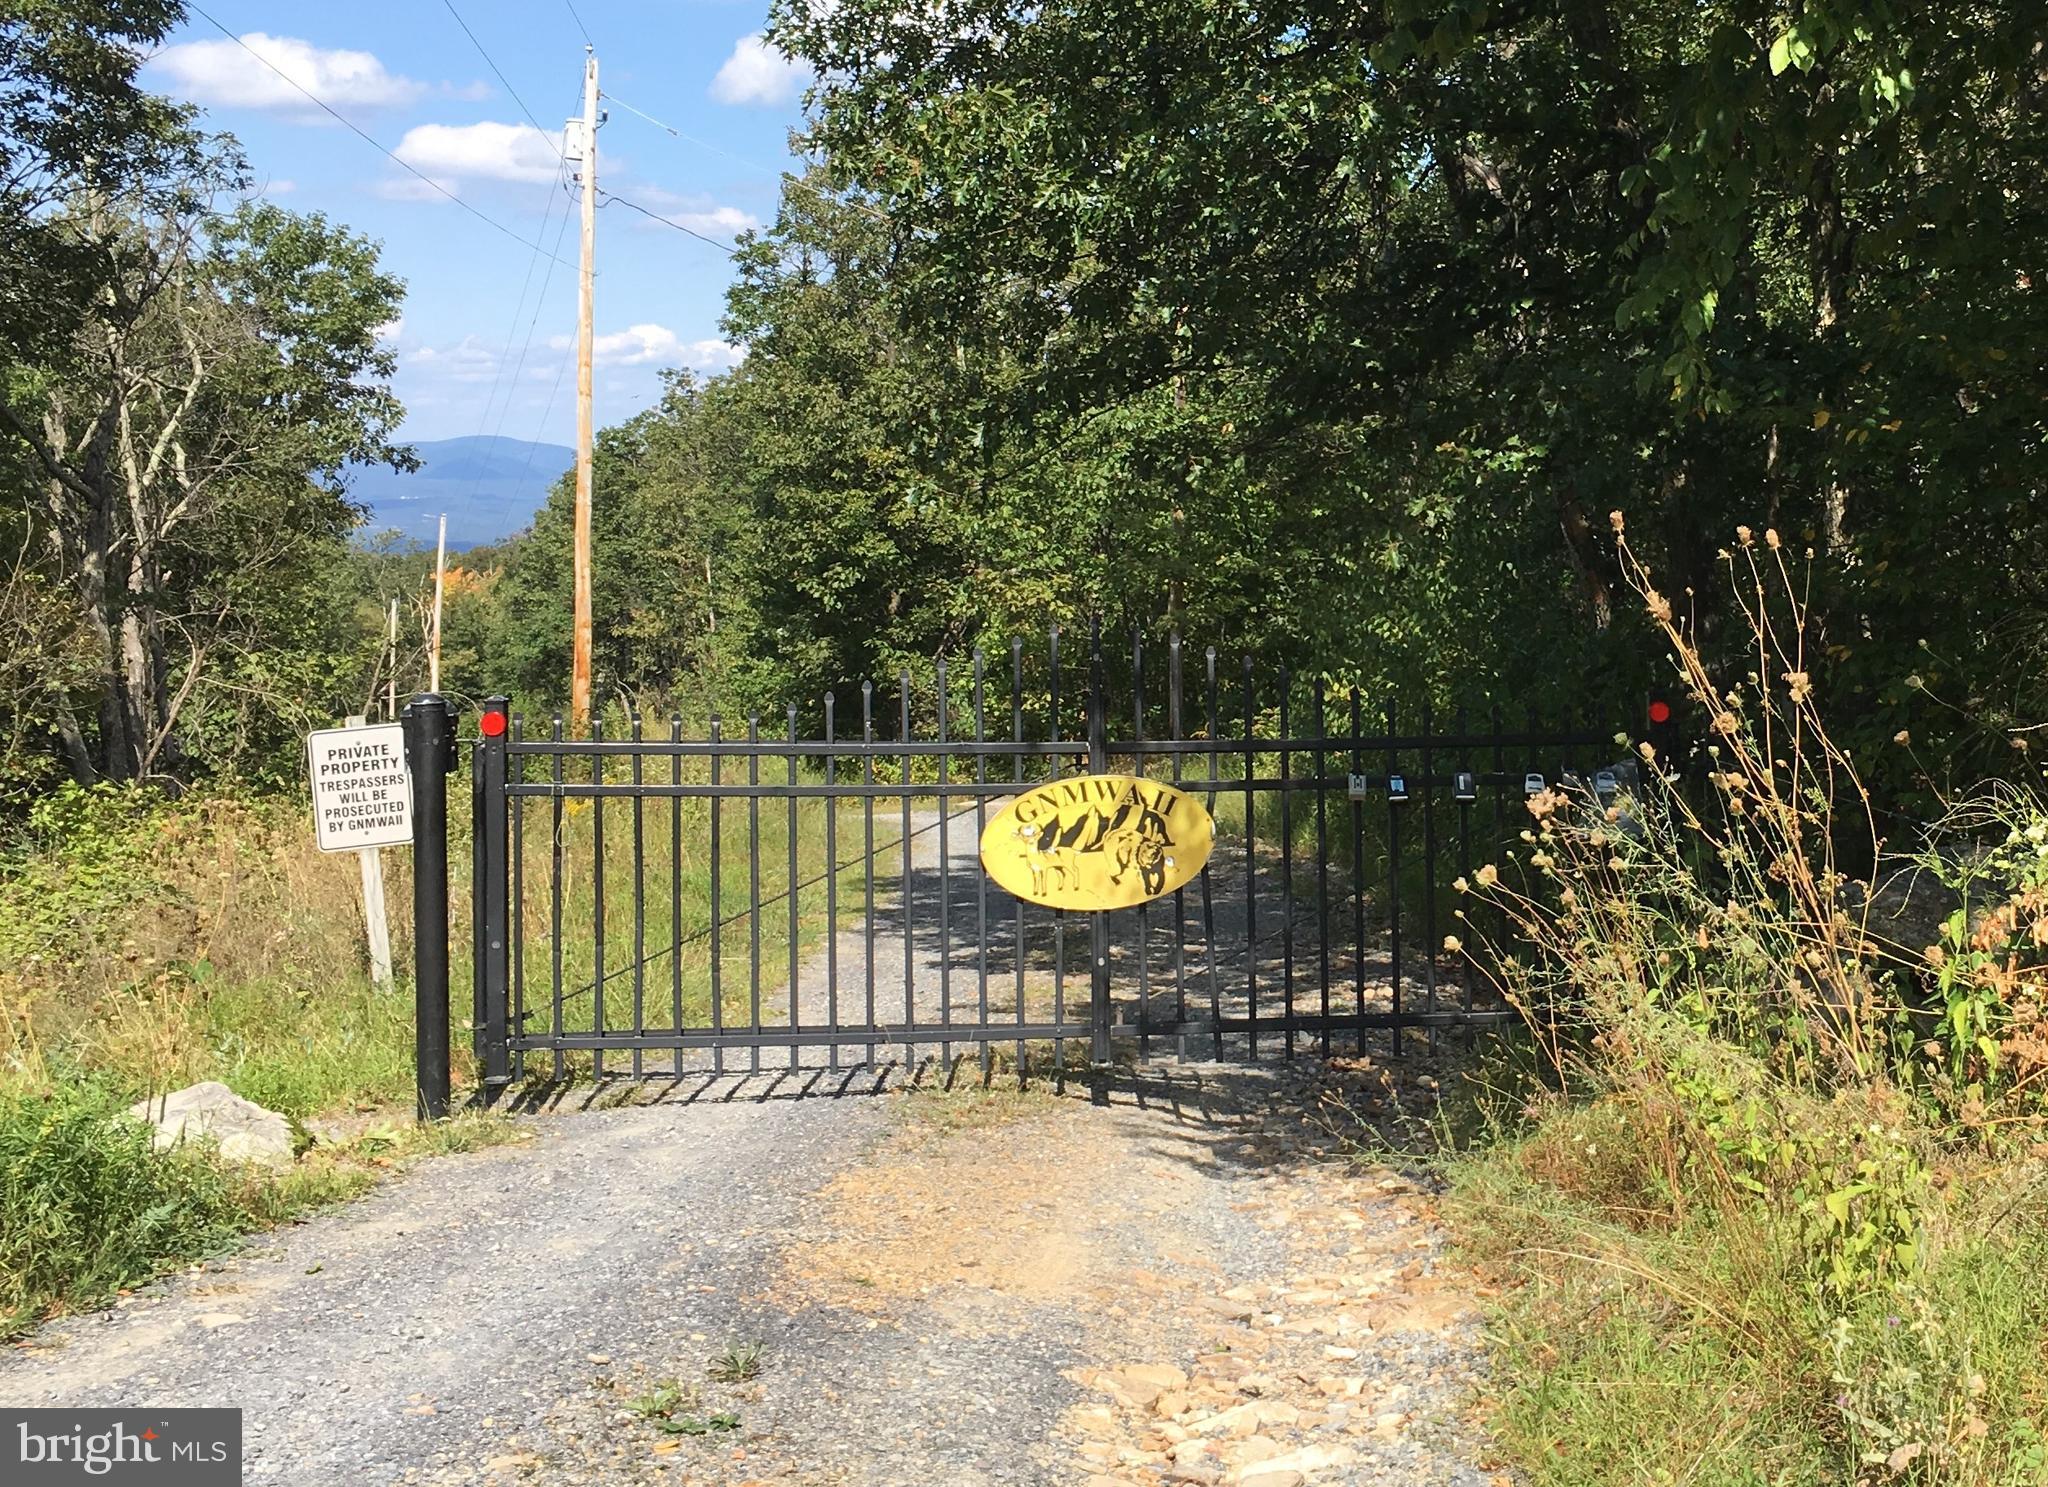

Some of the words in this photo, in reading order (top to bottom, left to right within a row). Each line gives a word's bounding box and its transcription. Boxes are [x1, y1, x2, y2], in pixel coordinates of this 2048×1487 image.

[328, 744, 390, 761] PRIVATE
[321, 757, 399, 776] PROPERTY
[320, 774, 405, 792] TRESPASSERS
[339, 792, 368, 804] WILL
[372, 789, 387, 800] BE
[325, 801, 404, 819] PROSECUTED
[329, 821, 344, 833] BY
[348, 815, 403, 831] GNMWAII
